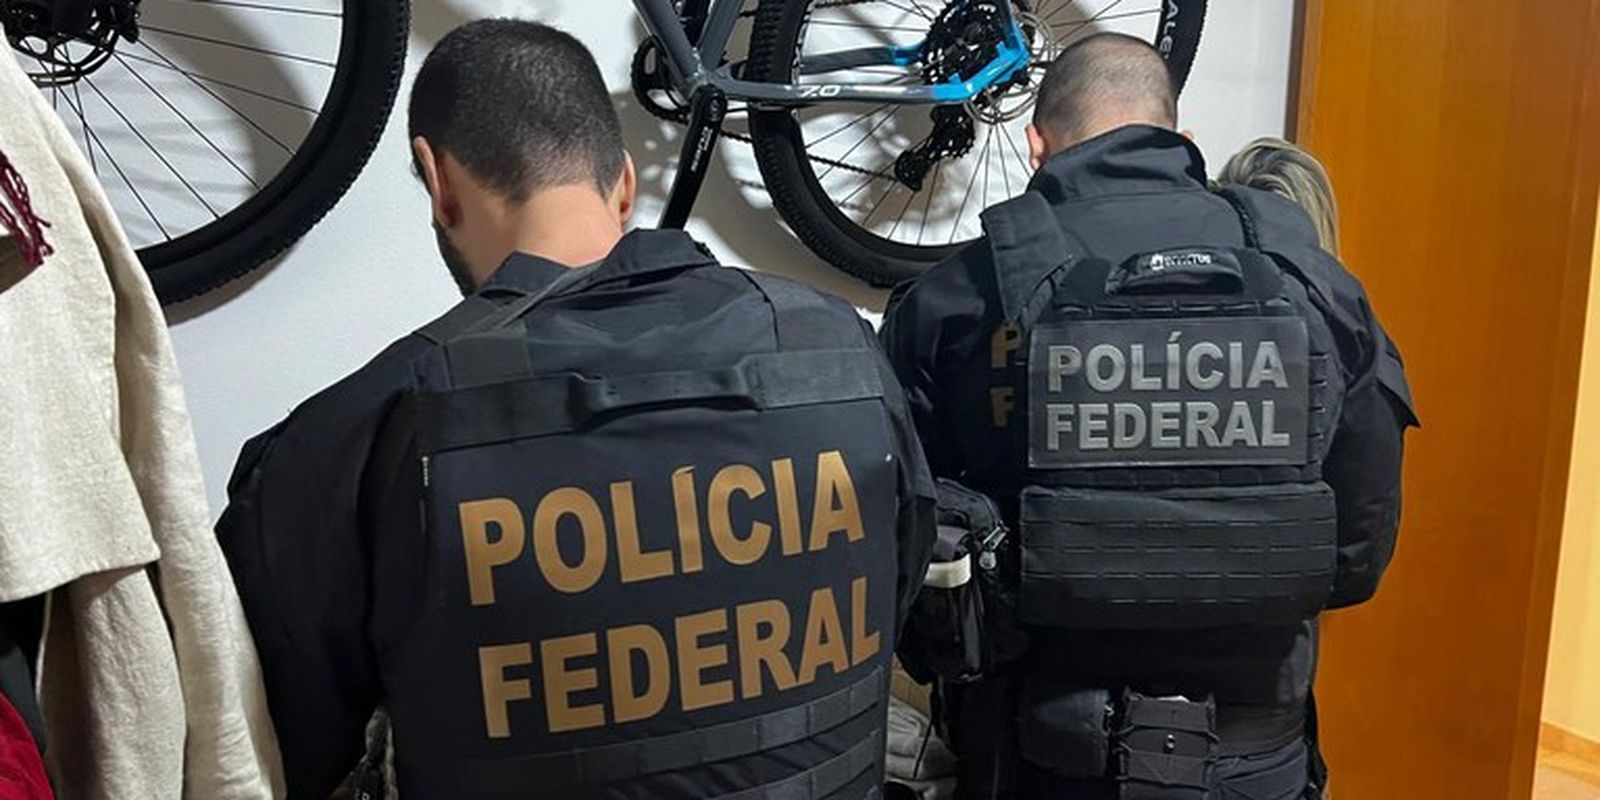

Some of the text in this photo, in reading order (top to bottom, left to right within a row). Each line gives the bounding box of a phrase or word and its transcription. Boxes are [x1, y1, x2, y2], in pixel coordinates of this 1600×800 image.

[798, 84, 840, 98] 7.0
[1048, 331, 1289, 393] POLÍCIA
[1045, 400, 1291, 451] FEDERAL
[478, 576, 881, 739] FEDERAL
